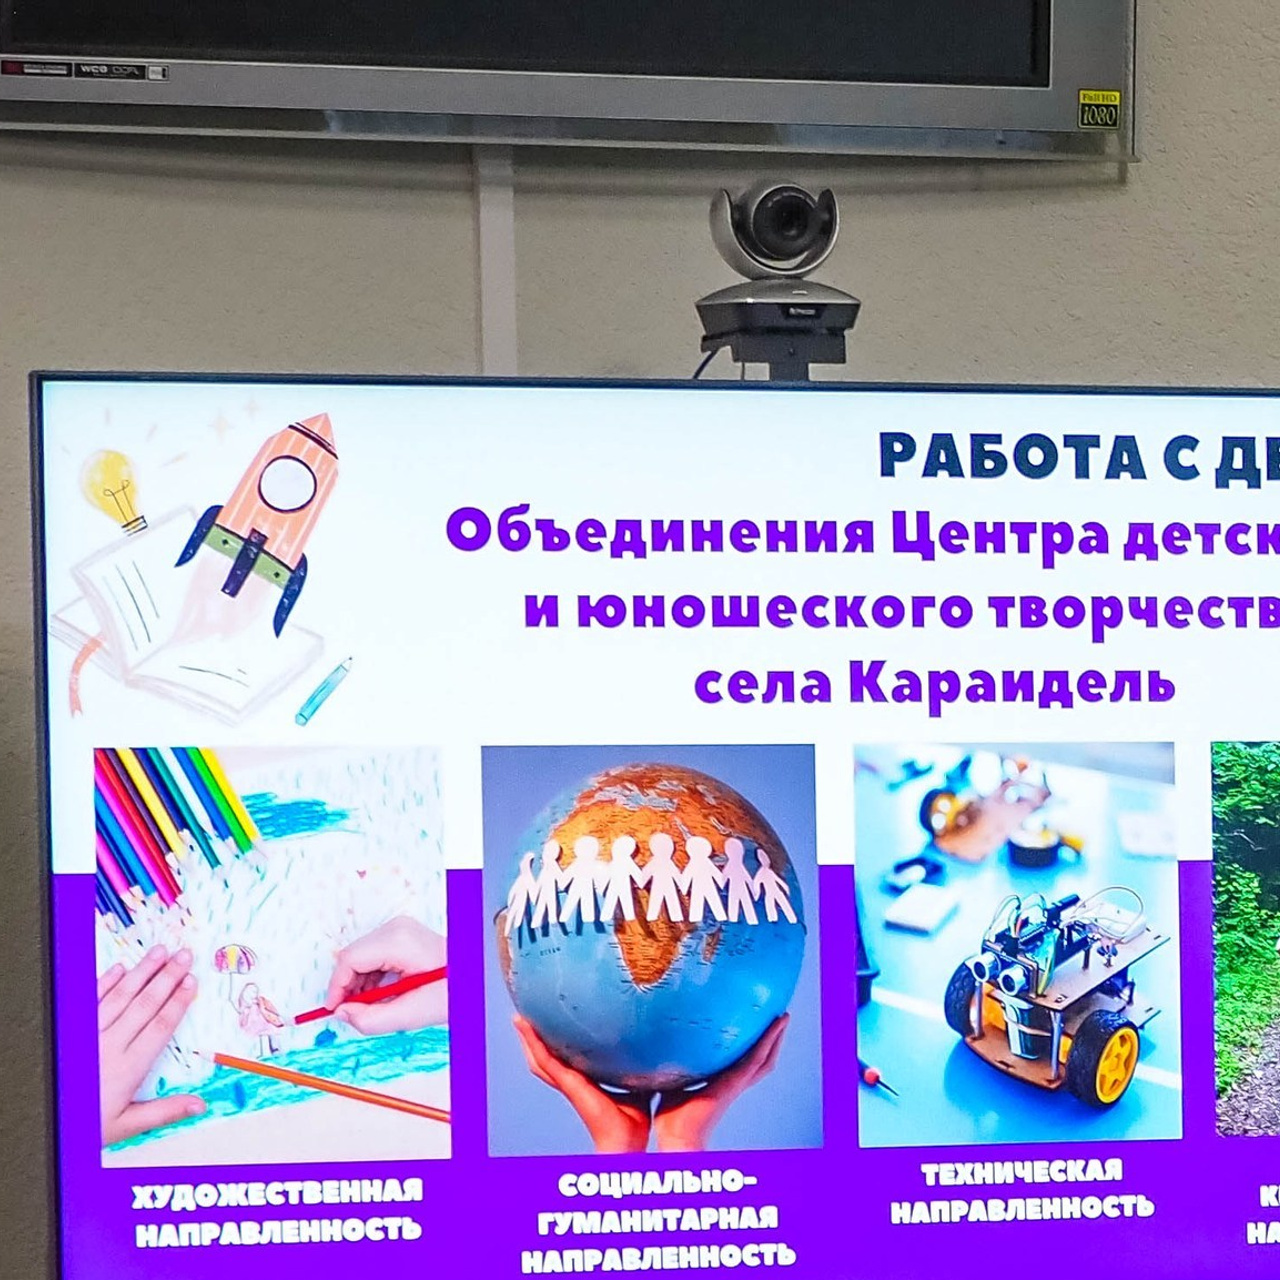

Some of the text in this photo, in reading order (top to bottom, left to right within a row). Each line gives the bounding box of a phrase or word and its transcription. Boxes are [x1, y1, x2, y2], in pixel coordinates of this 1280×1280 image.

[1083, 106, 1116, 125] 1080
[880, 432, 1147, 479] РАБОТА
[1164, 435, 1200, 480] С
[446, 503, 874, 559] Объединения
[892, 510, 1109, 569] Центра
[524, 594, 559, 628] и
[577, 594, 974, 629] юношеского
[694, 661, 1176, 718] села Караидель
[558, 1169, 758, 1199] СОЦИАЛЬНО-
[920, 1158, 1123, 1187] ТЕХНИЧЕСКАЯ
[131, 1177, 423, 1210] ХУДОЖЕСТВЕННАЯ
[537, 1206, 779, 1236] ГУМАНИТАРНАЯ
[890, 1194, 1155, 1225] НАПРАВЛЕННОСТЬ
[135, 1217, 422, 1248] НАПРАВЛЕННОСТЬ
[521, 1242, 797, 1274] НАПРАВЛЕННОСТЬ
